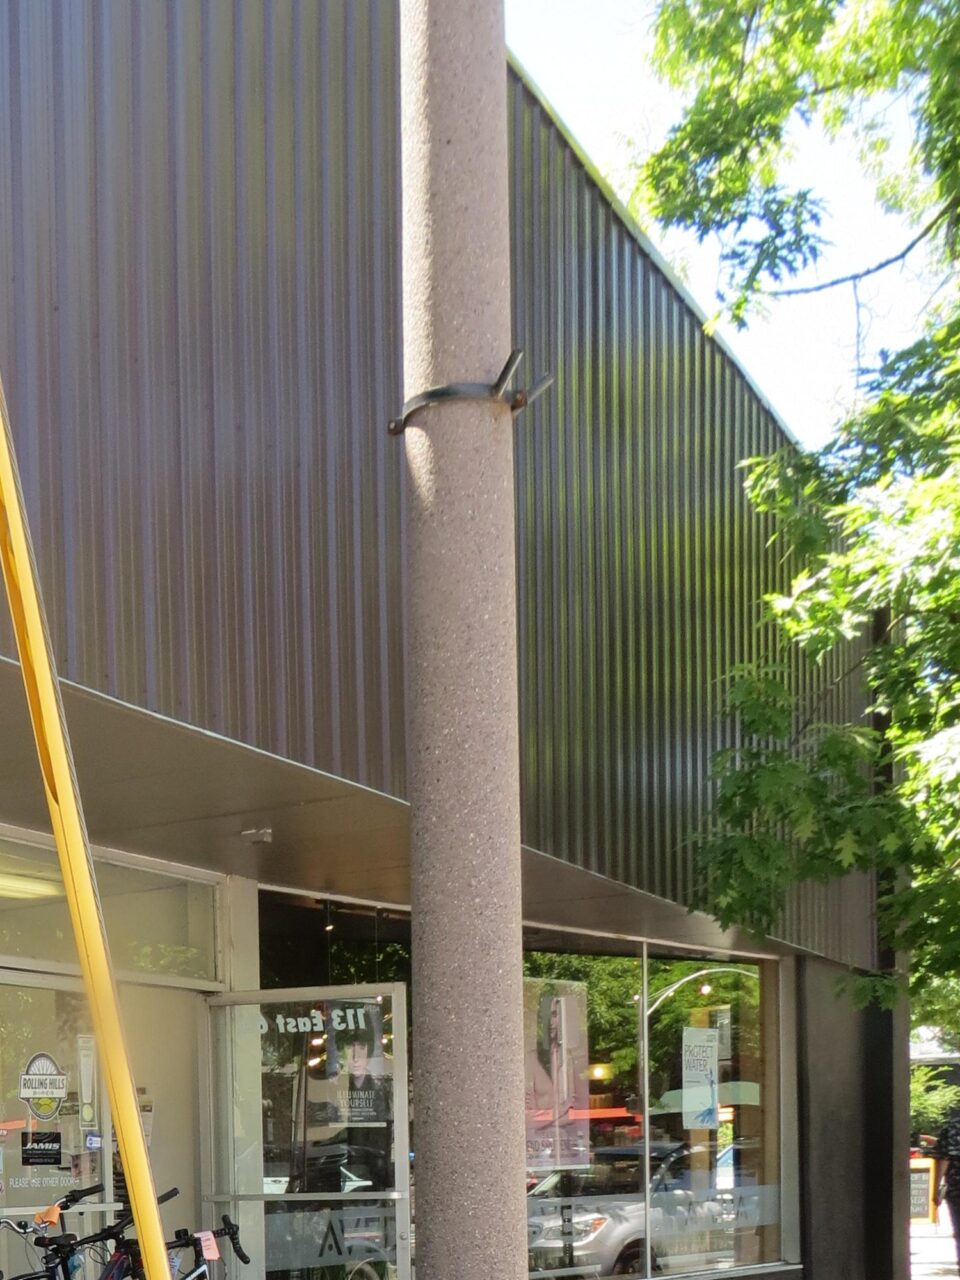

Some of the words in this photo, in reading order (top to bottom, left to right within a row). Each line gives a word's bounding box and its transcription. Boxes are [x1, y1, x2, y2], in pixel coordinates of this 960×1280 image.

[22, 1077, 48, 1090] ROLLING
[49, 1077, 65, 1090] HILLS
[22, 1142, 60, 1150] JAMIS
[9, 1177, 29, 1188] PLEASE
[42, 1176, 59, 1187] OTHER
